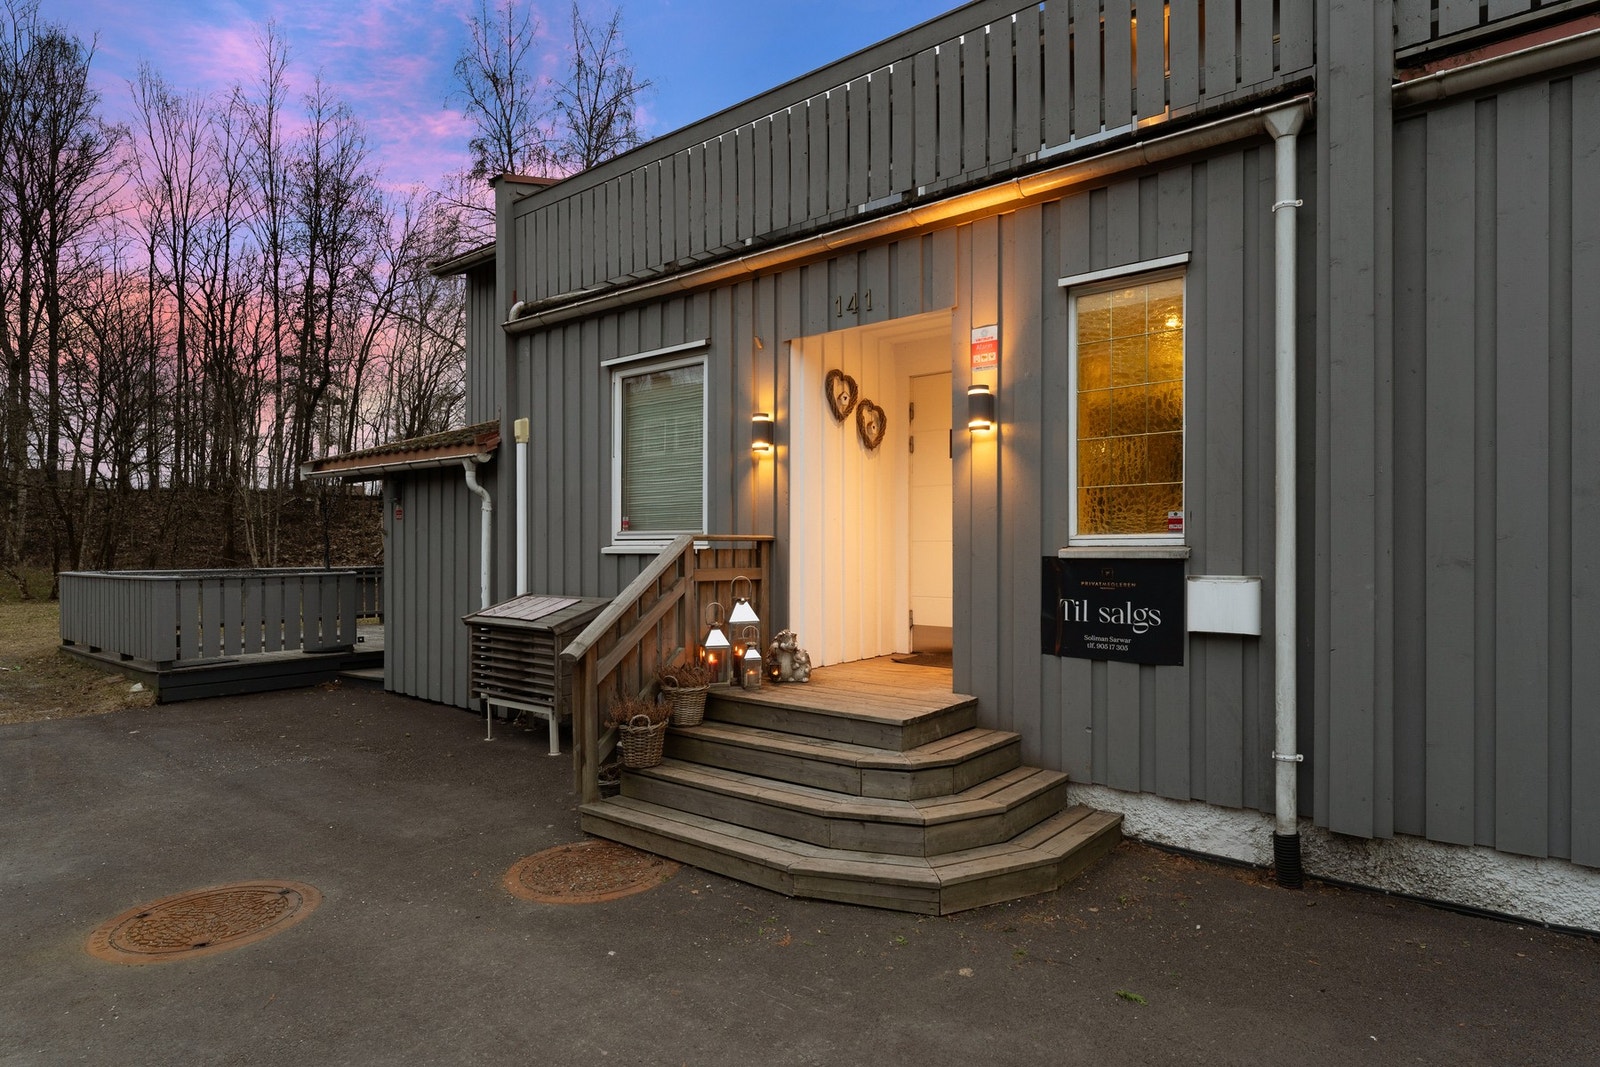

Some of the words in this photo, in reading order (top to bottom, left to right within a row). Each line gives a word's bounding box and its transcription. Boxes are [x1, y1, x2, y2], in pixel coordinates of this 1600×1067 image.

[835, 289, 872, 317] 141
[1060, 599, 1088, 622] Til
[1098, 601, 1161, 634] salgs
[1083, 634, 1109, 642] Soliman
[1109, 636, 1131, 644] Sarwar
